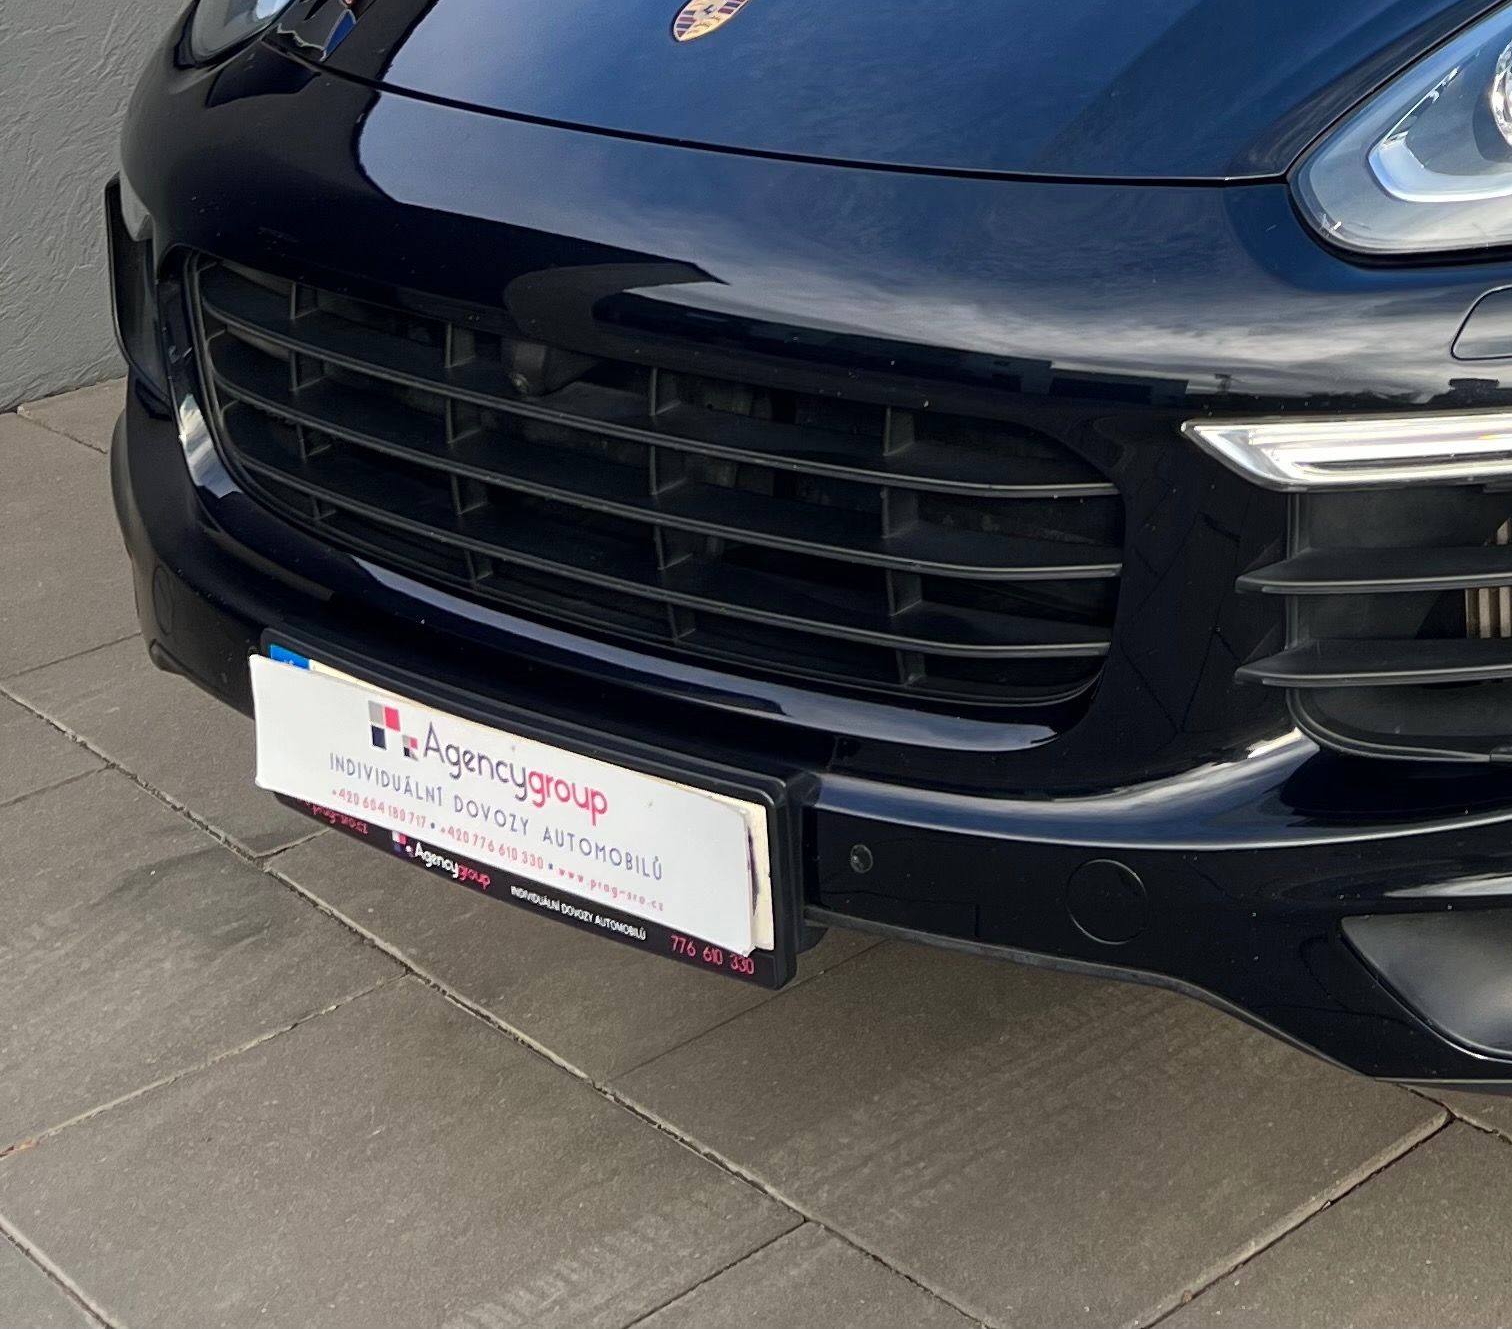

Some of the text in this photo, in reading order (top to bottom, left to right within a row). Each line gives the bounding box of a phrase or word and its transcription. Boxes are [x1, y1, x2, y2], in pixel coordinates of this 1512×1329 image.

[423, 721, 609, 826] Agencygroup
[330, 752, 663, 881] INDIVIDUÁLNÍ DOVOZY AUTOMOBILŮ
[409, 811, 427, 828] 717
[473, 833, 495, 853] 776
[498, 843, 518, 861] 610
[521, 850, 544, 870] 330
[671, 934, 755, 975] 776 610 330
